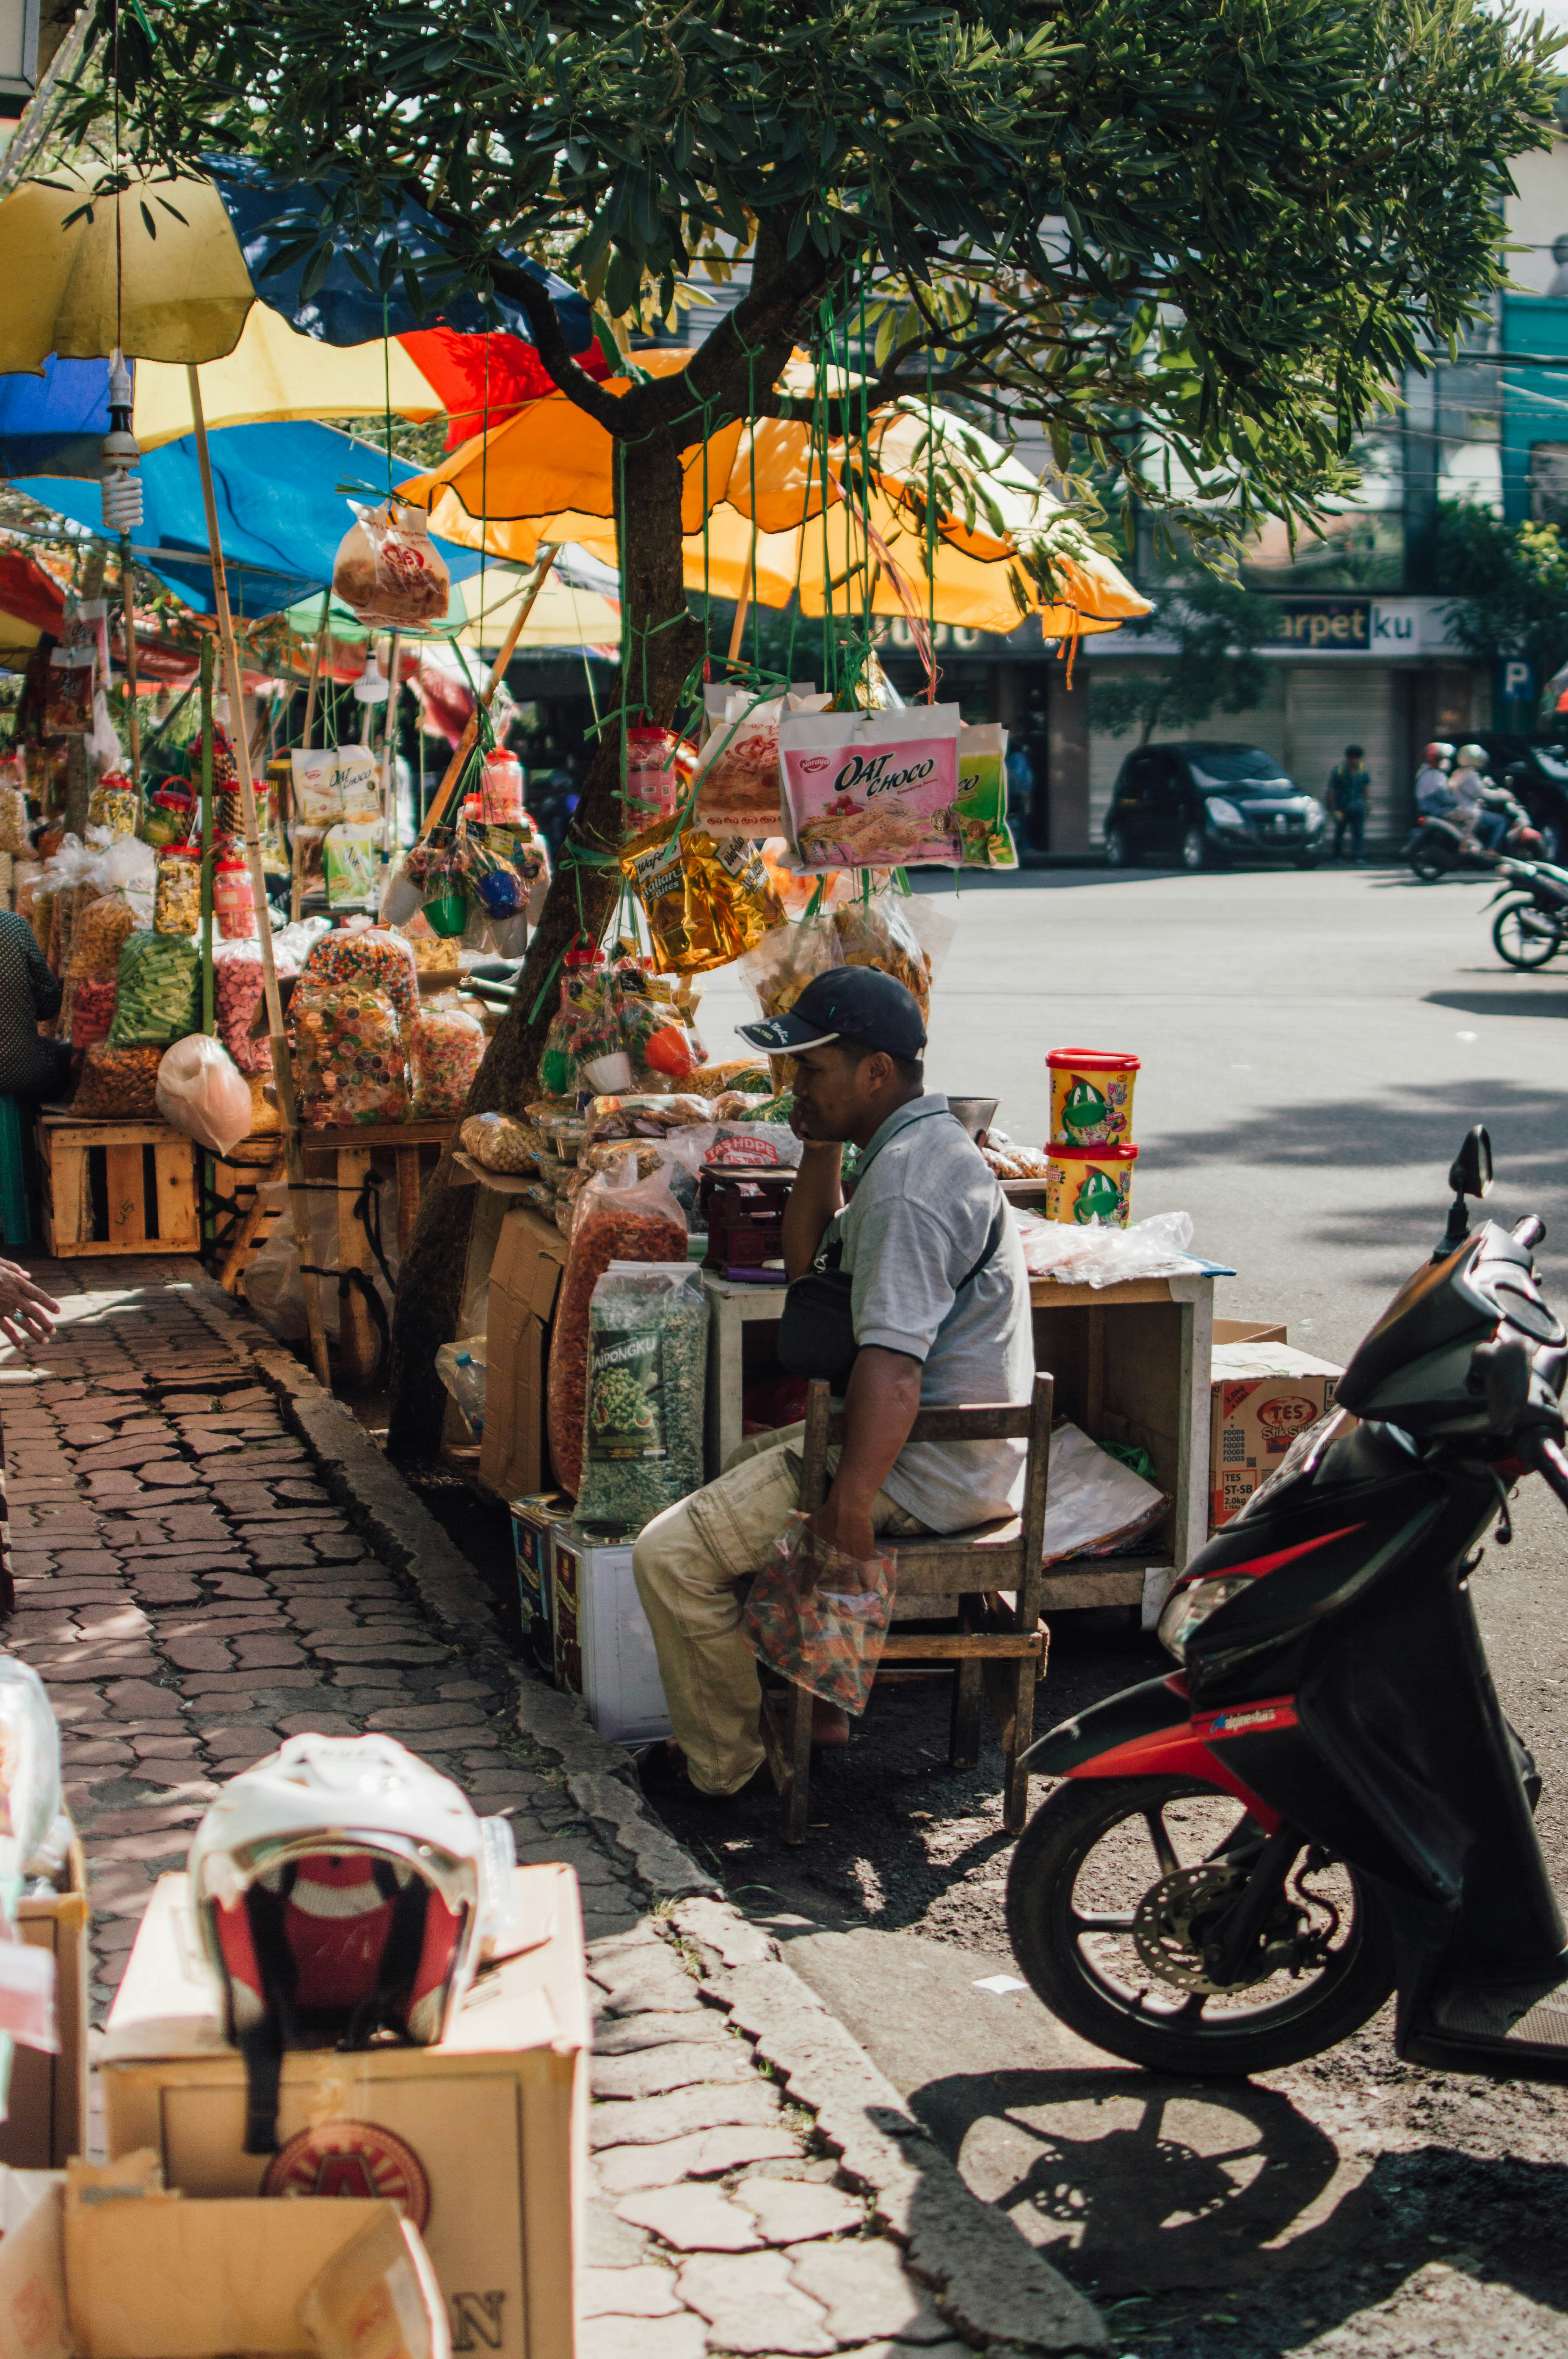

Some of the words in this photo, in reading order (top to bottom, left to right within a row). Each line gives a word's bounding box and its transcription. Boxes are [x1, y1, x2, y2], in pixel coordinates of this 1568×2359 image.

[1279, 608, 1366, 645] arpet
[1374, 607, 1412, 638] ku
[1506, 662, 1528, 692] P
[802, 757, 830, 769] Naraya
[834, 752, 895, 791] OAT
[866, 759, 934, 797] CHOCO
[655, 880, 680, 899] Bites
[707, 1139, 731, 1158] TAS
[733, 1138, 774, 1157] HDPE
[1225, 1385, 1245, 1404] 2.0kg
[1270, 1404, 1303, 1420] TES
[1261, 1425, 1286, 1440] Stik
[1225, 1485, 1252, 1494] ST-SB
[1225, 1497, 1246, 1505] 2.0kg
[1224, 1709, 1276, 1732] alpinestars
